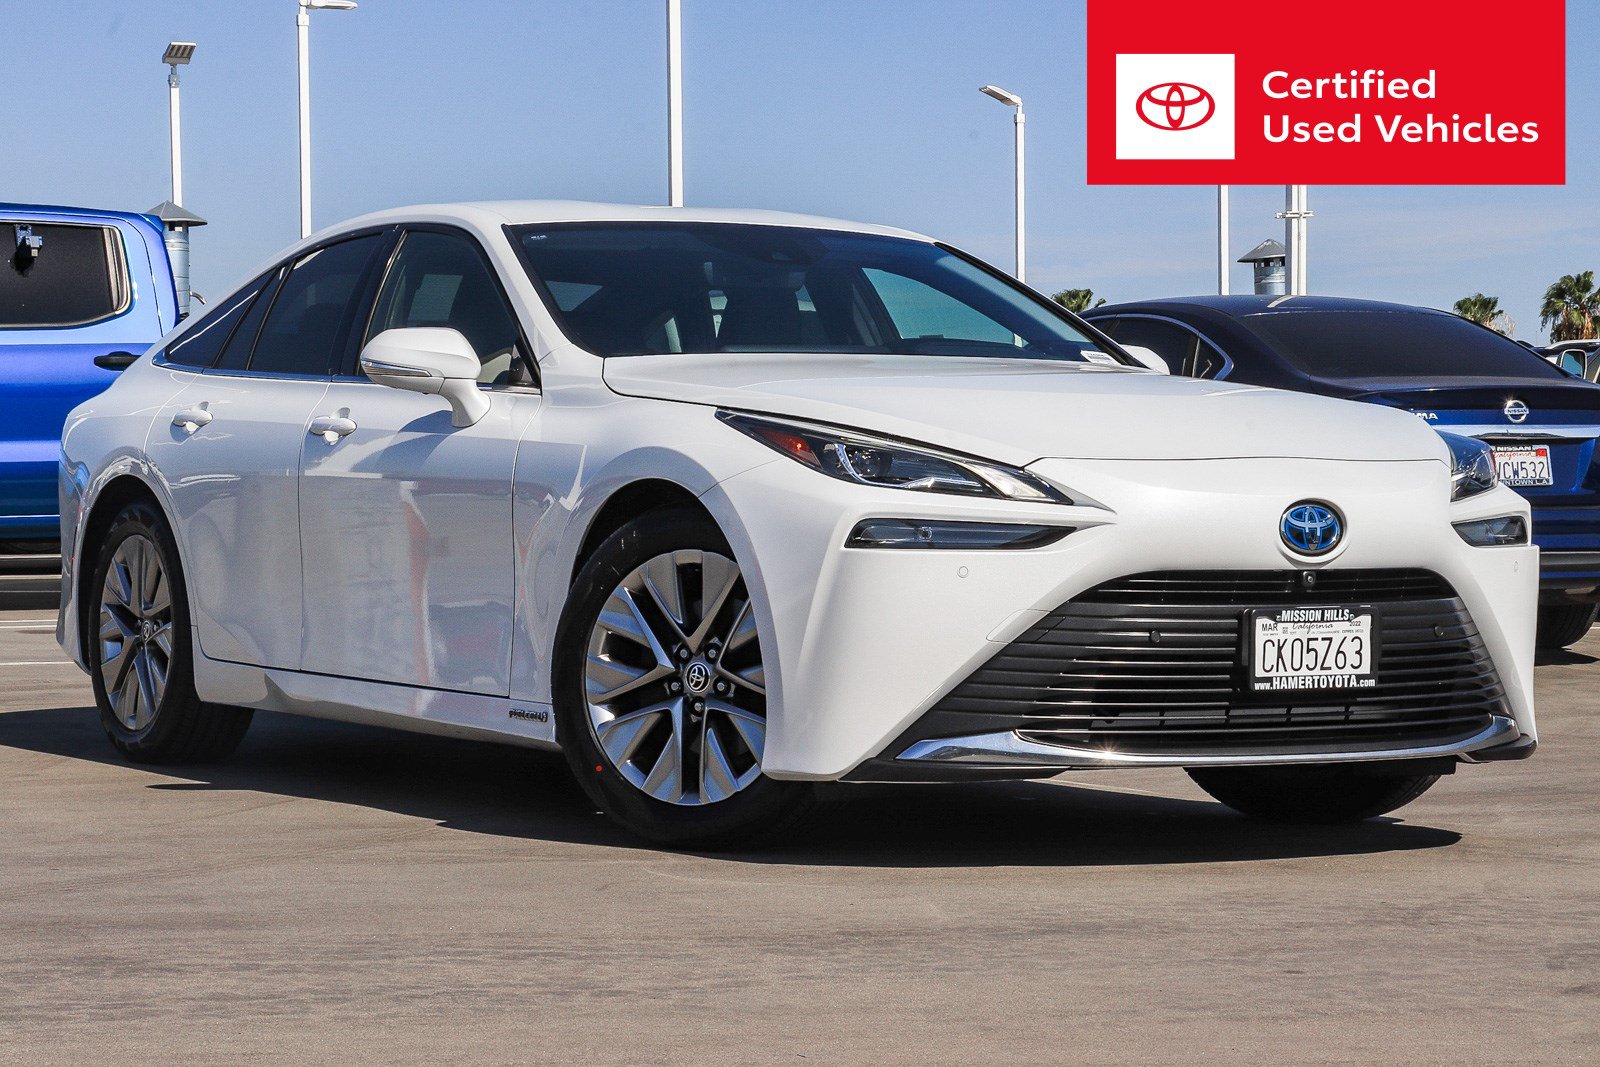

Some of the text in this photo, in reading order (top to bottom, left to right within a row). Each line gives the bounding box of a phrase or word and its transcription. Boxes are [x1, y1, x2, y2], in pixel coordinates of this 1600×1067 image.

[1281, 609, 1350, 622] MISSION HILLS
[1261, 623, 1279, 632] MAR
[1292, 622, 1334, 635] California
[1262, 636, 1363, 673] CK05Z63
[1254, 675, 1376, 690] www.HAMERTOYOTA.com
